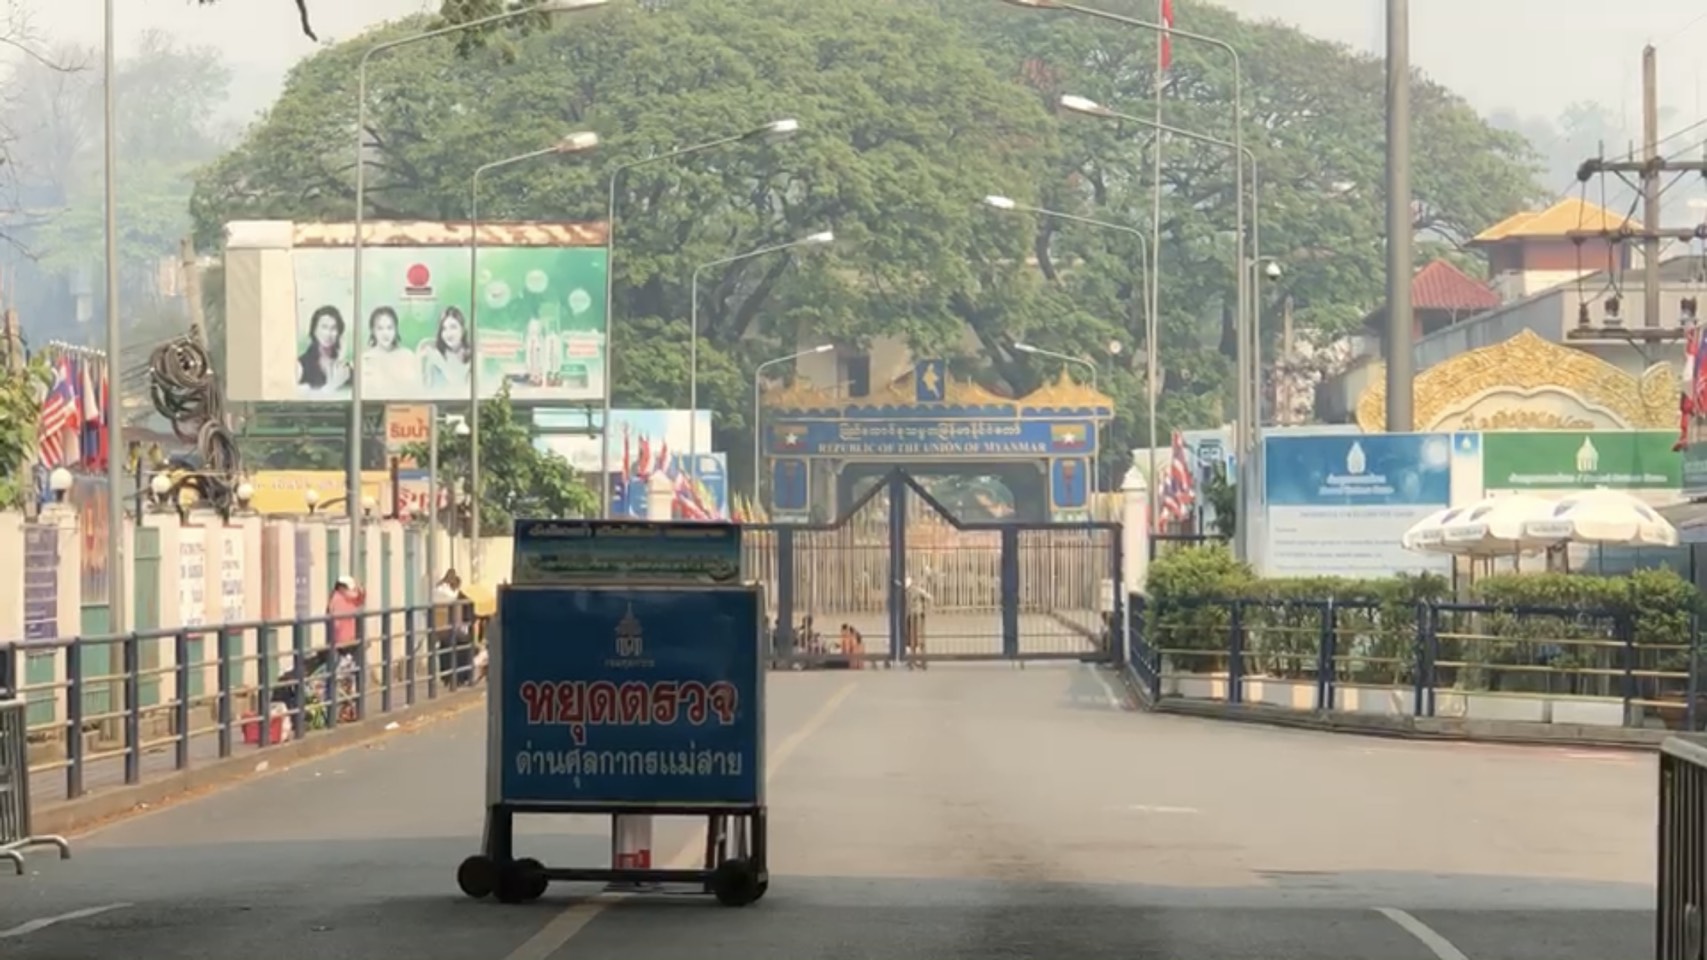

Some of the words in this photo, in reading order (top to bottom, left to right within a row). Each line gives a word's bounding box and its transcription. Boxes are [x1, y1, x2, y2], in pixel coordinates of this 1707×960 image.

[818, 442, 873, 453] REPUBLIC
[877, 442, 893, 453] OF
[897, 442, 919, 453] THE
[923, 442, 962, 453] UNION
[963, 442, 979, 453] OF
[983, 441, 1047, 453] MYANMAR
[519, 680, 739, 746] หยุดตรวจ
[515, 740, 743, 789] ด่านศุลกากรแม่สาย
